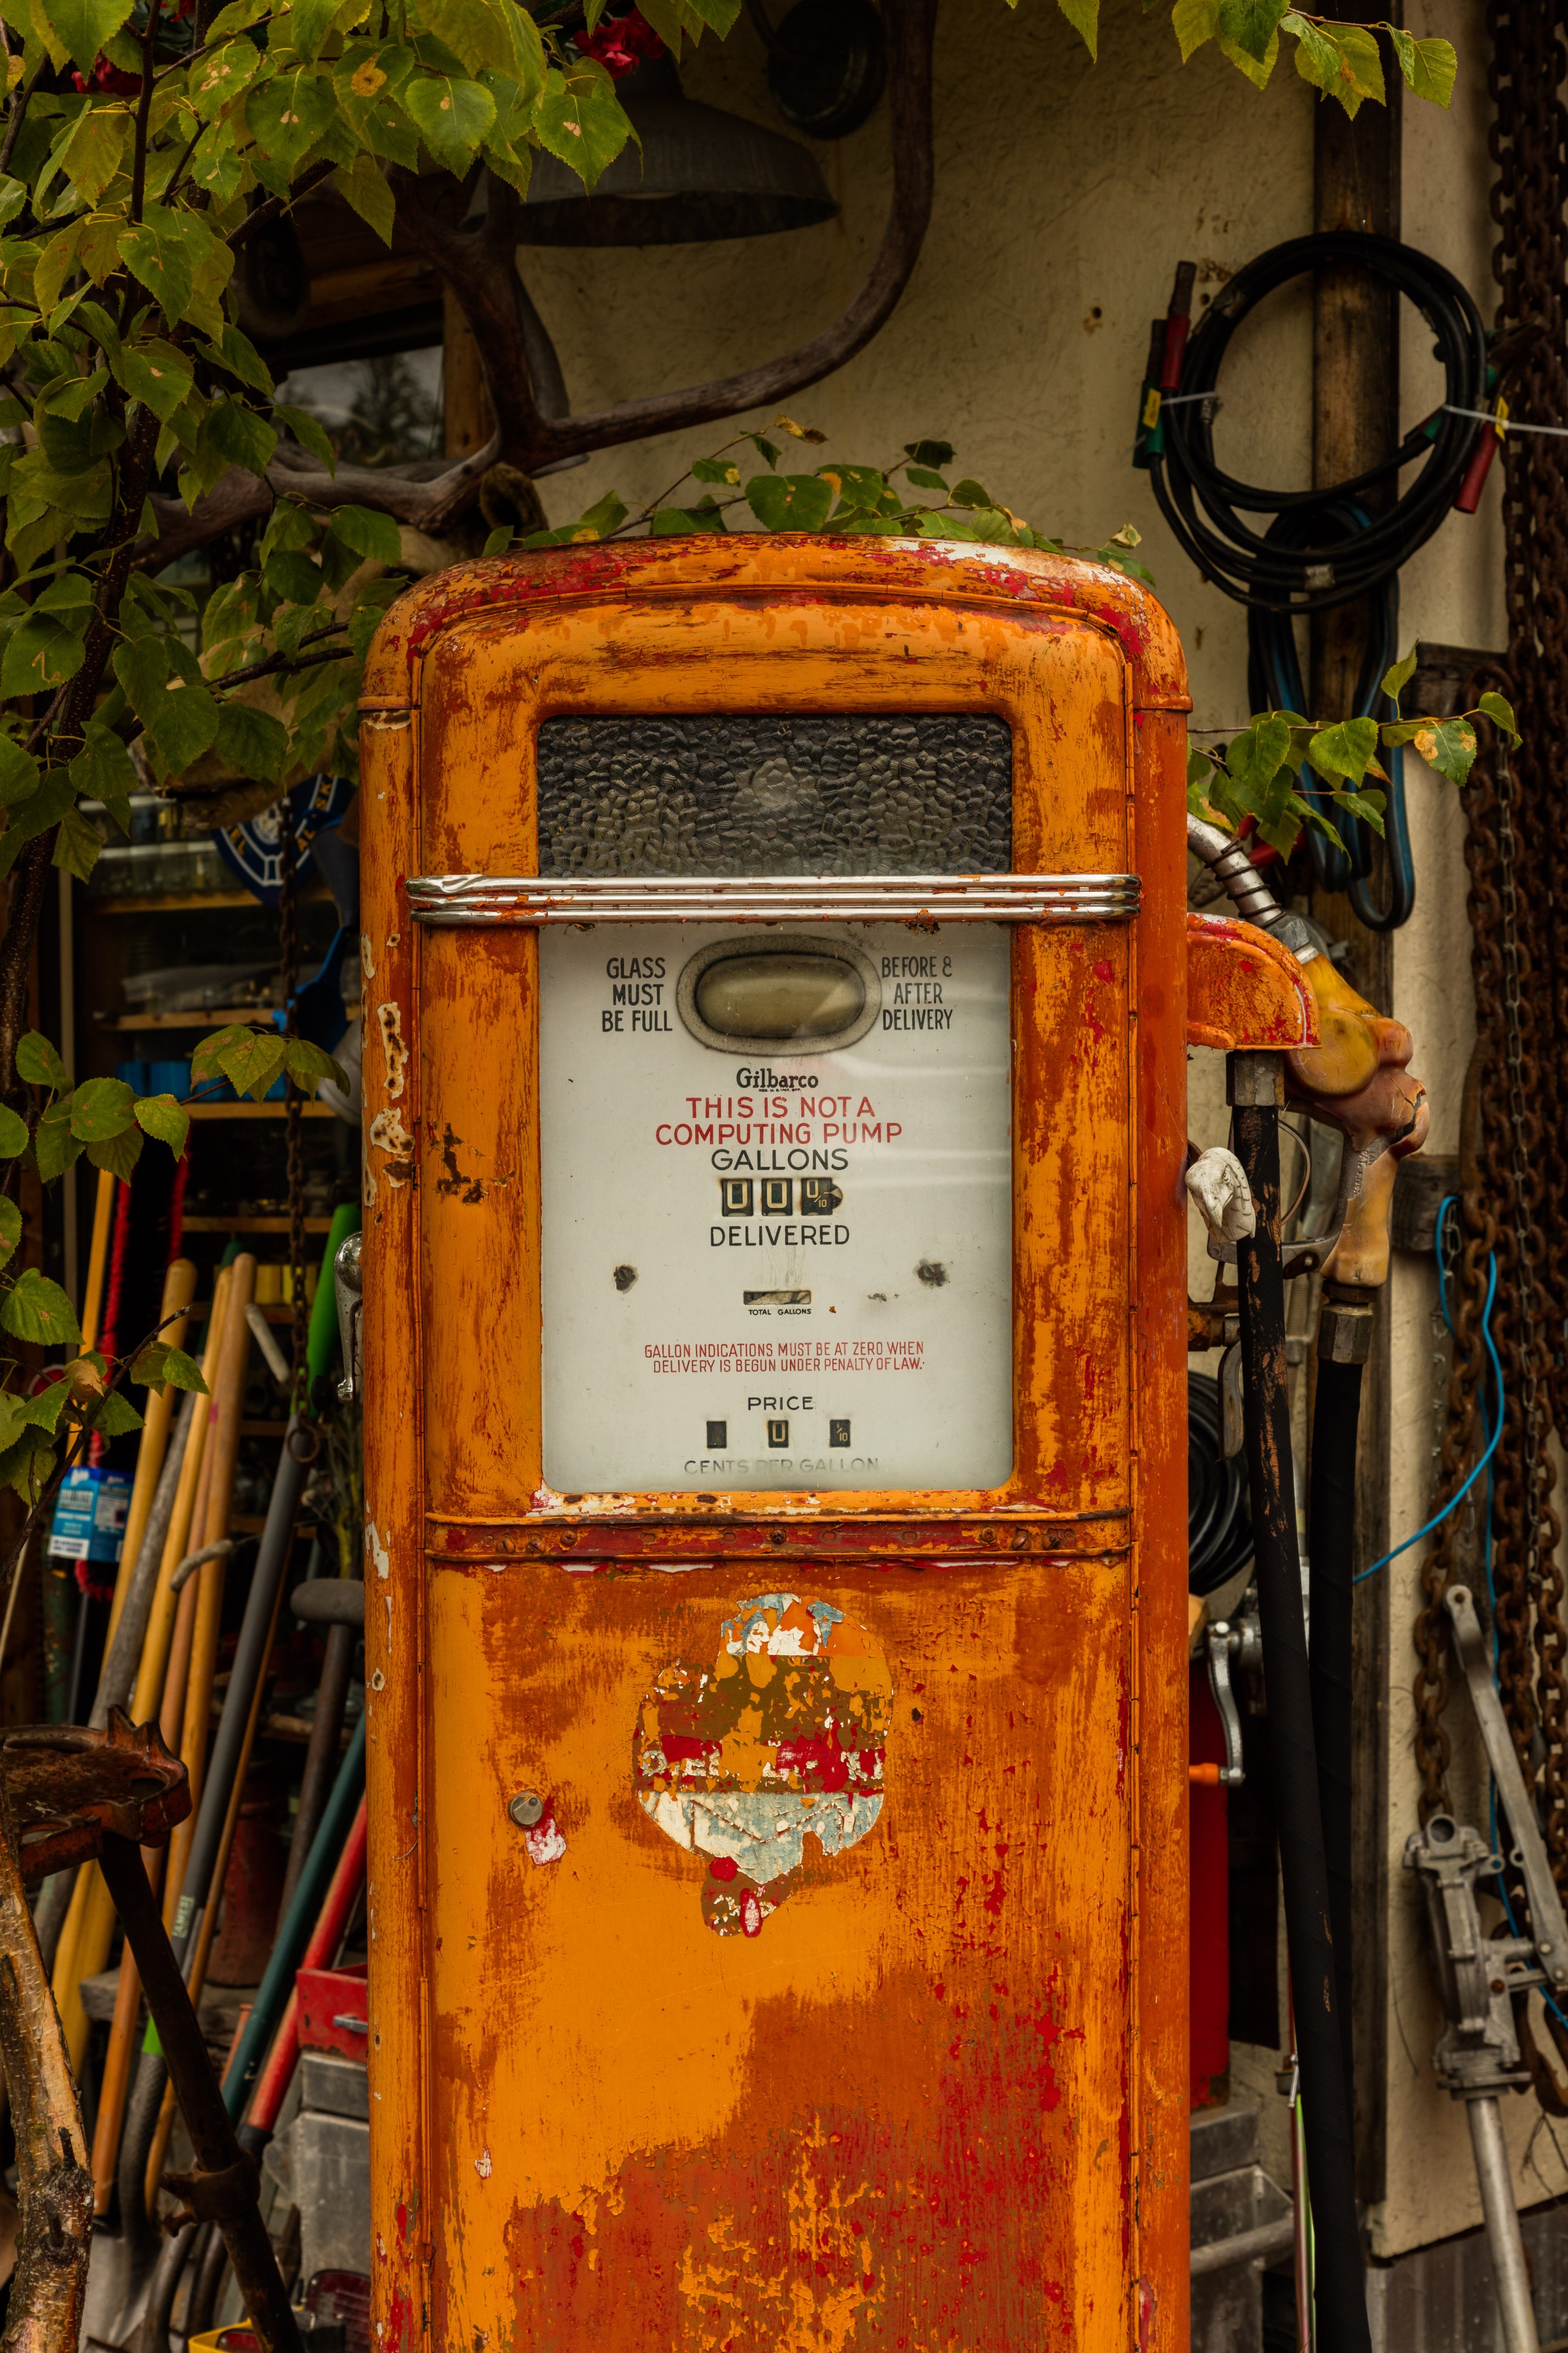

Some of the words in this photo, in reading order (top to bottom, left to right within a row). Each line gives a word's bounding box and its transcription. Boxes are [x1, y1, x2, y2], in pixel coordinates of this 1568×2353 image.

[606, 957, 666, 979] GLASS
[882, 956, 937, 979] BEFORE
[612, 984, 664, 1006] MUST
[893, 982, 943, 1004] AFTER
[602, 1011, 624, 1032] BE
[632, 1010, 673, 1032] FULL
[882, 1009, 953, 1031] DELIVERY
[736, 1067, 819, 1089] Gilbarco
[686, 1096, 753, 1119] THIS
[764, 1096, 788, 1119] IS
[800, 1096, 852, 1118] NOT
[857, 1096, 875, 1117] A
[656, 1123, 810, 1146] COMPUTING
[823, 1122, 902, 1144] PUMP
[711, 1148, 849, 1171] GALLONS
[727, 1179, 748, 1209] 0
[767, 1179, 788, 1208] 0
[710, 1225, 850, 1247] DELIVERED
[645, 1344, 690, 1358] GALLON
[696, 1343, 773, 1357] INDICATIONS
[778, 1342, 812, 1357] MUST
[816, 1342, 830, 1356] BE
[835, 1342, 849, 1356] AT
[853, 1342, 883, 1356] ZERO
[887, 1341, 923, 1355] WHEN
[654, 1359, 715, 1373] DELIVERY
[720, 1359, 731, 1372] IS
[736, 1359, 776, 1372] BEGUN
[781, 1358, 820, 1372] UNDER
[825, 1358, 873, 1371] PENALTY
[876, 1358, 892, 1371] OF
[894, 1357, 923, 1371] LAW.
[748, 1396, 814, 1411] PRICE
[772, 1421, 786, 1442] 0
[684, 1460, 749, 1474] CENTS
[800, 1458, 879, 1473] GALLON
